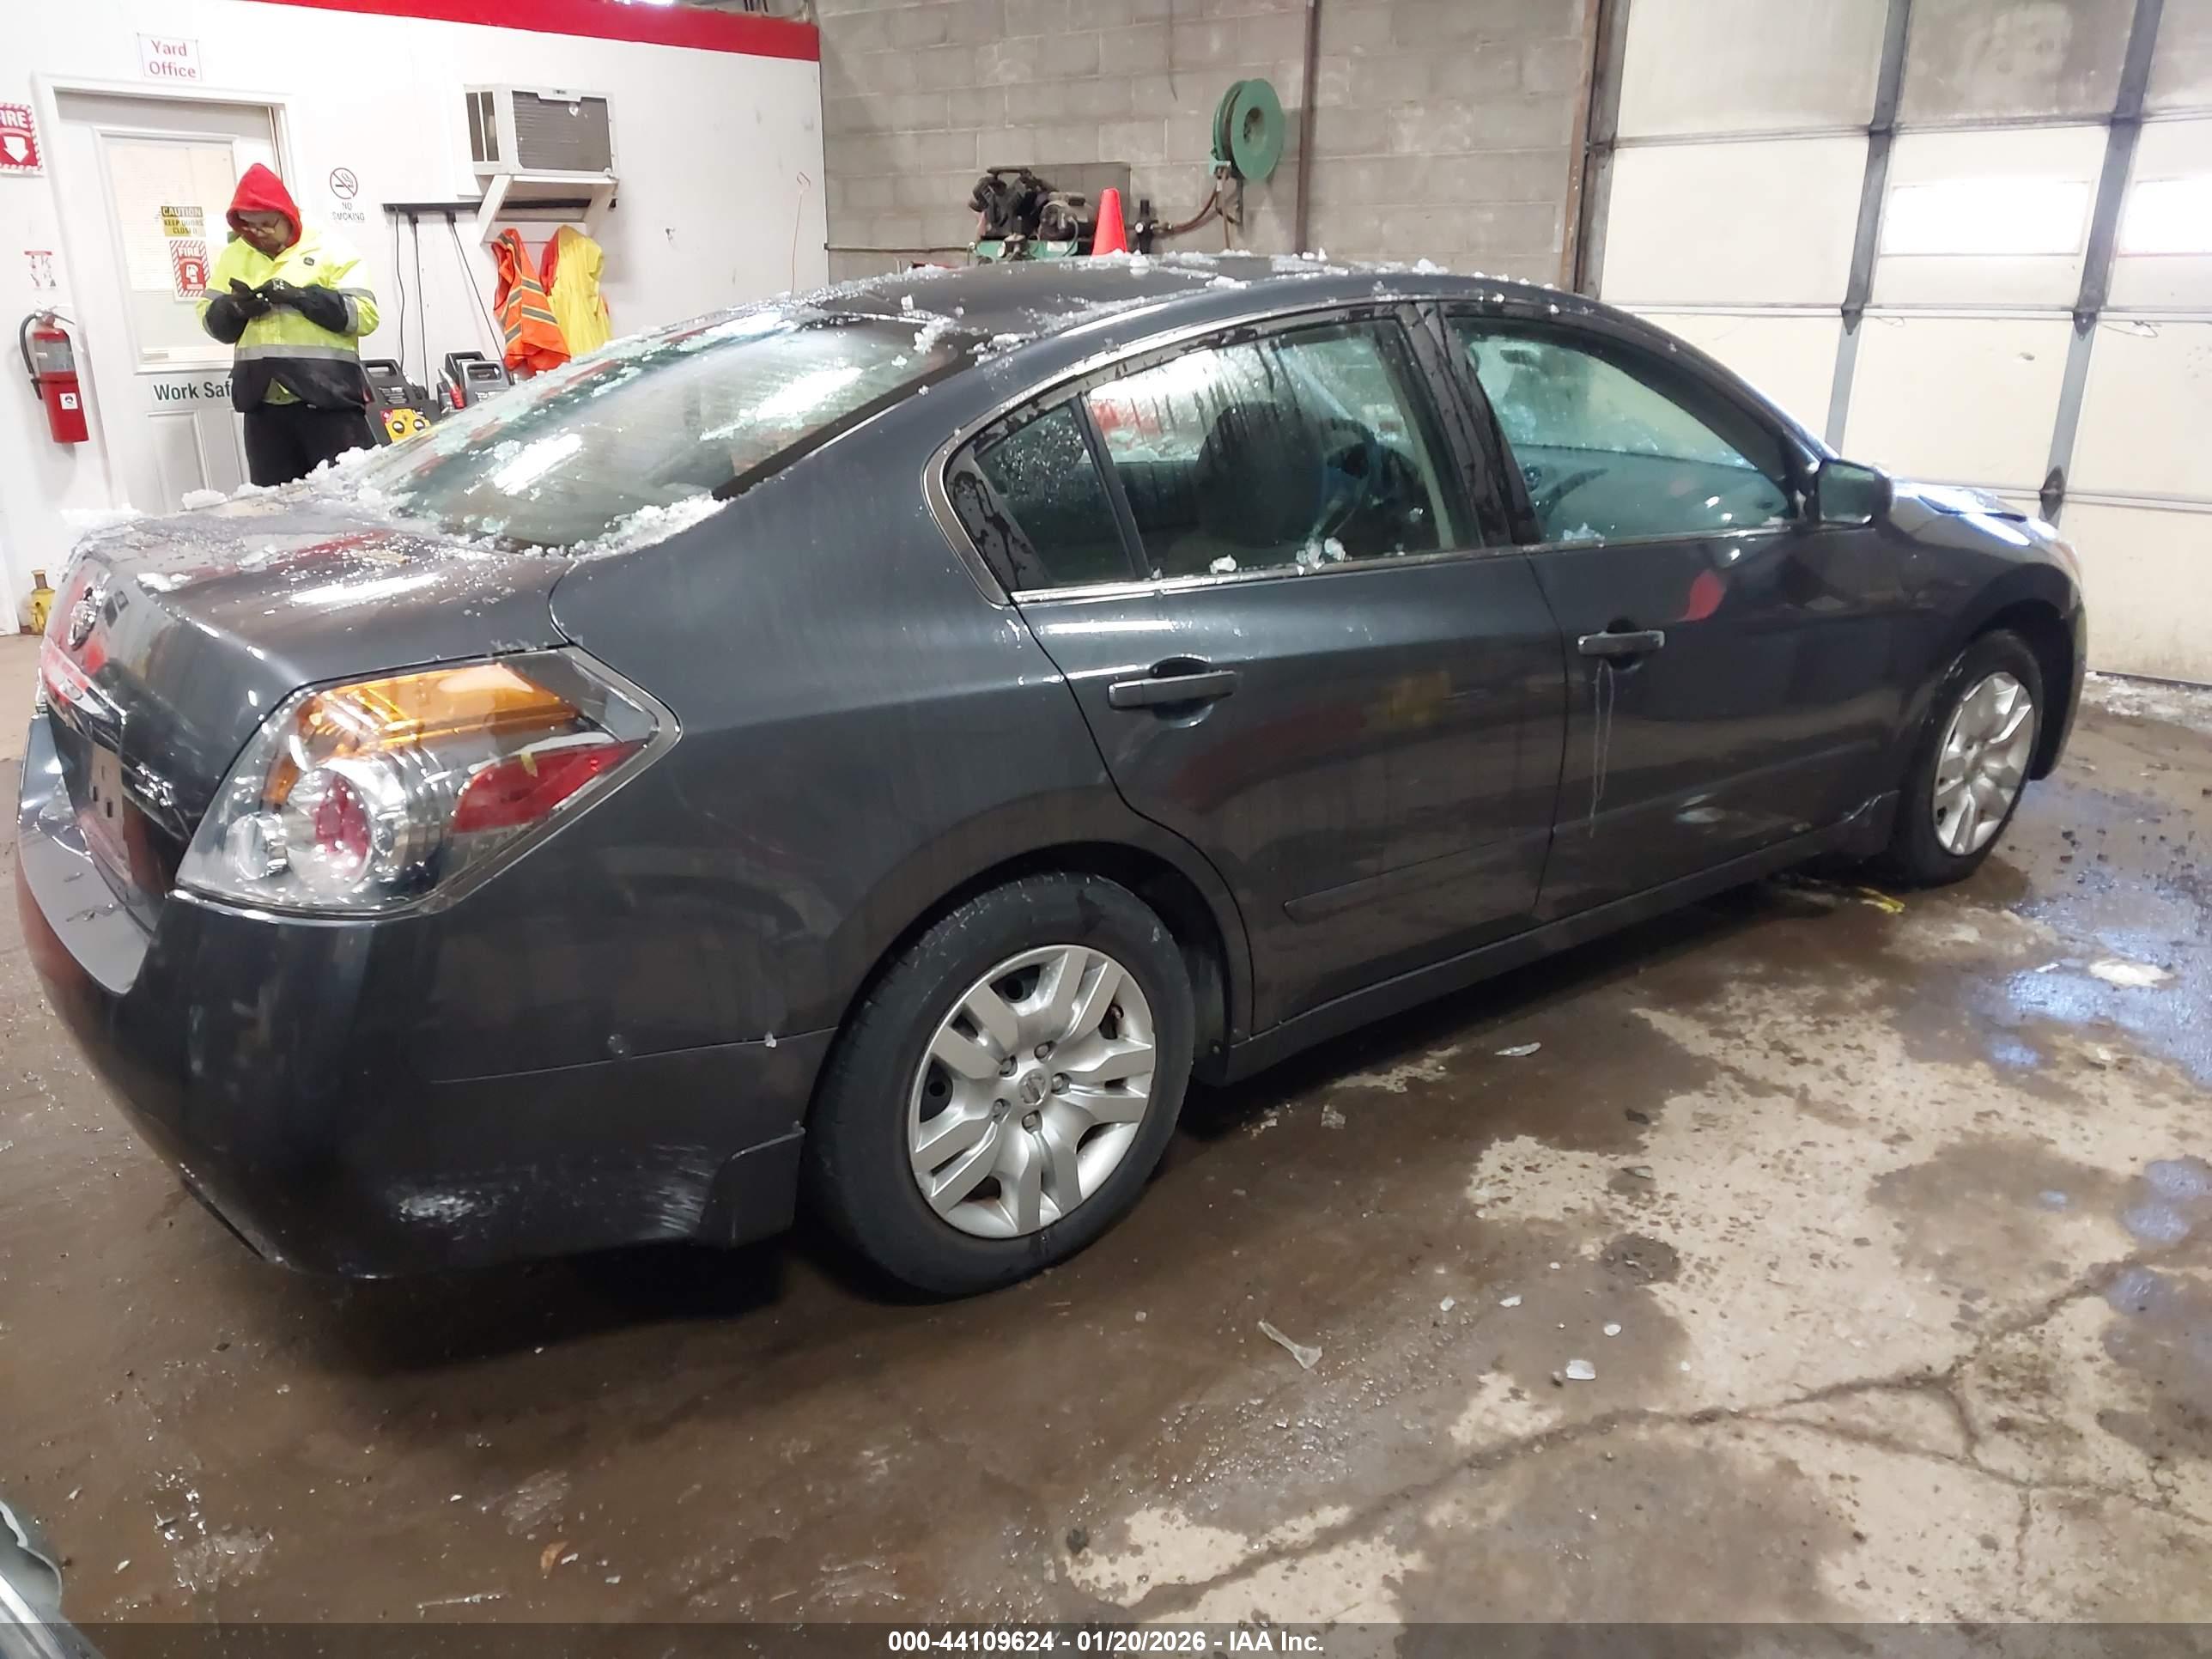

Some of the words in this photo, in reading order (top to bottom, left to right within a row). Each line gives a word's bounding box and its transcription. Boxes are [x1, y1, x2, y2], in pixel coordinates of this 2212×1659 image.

[150, 40, 187, 57] Yard
[149, 61, 197, 78] Office
[0, 109, 29, 129] IRE
[161, 206, 204, 217] CAUTION
[341, 201, 353, 211] NO
[177, 246, 201, 258] FIRE
[153, 382, 199, 401] Work
[204, 380, 231, 398] Saf
